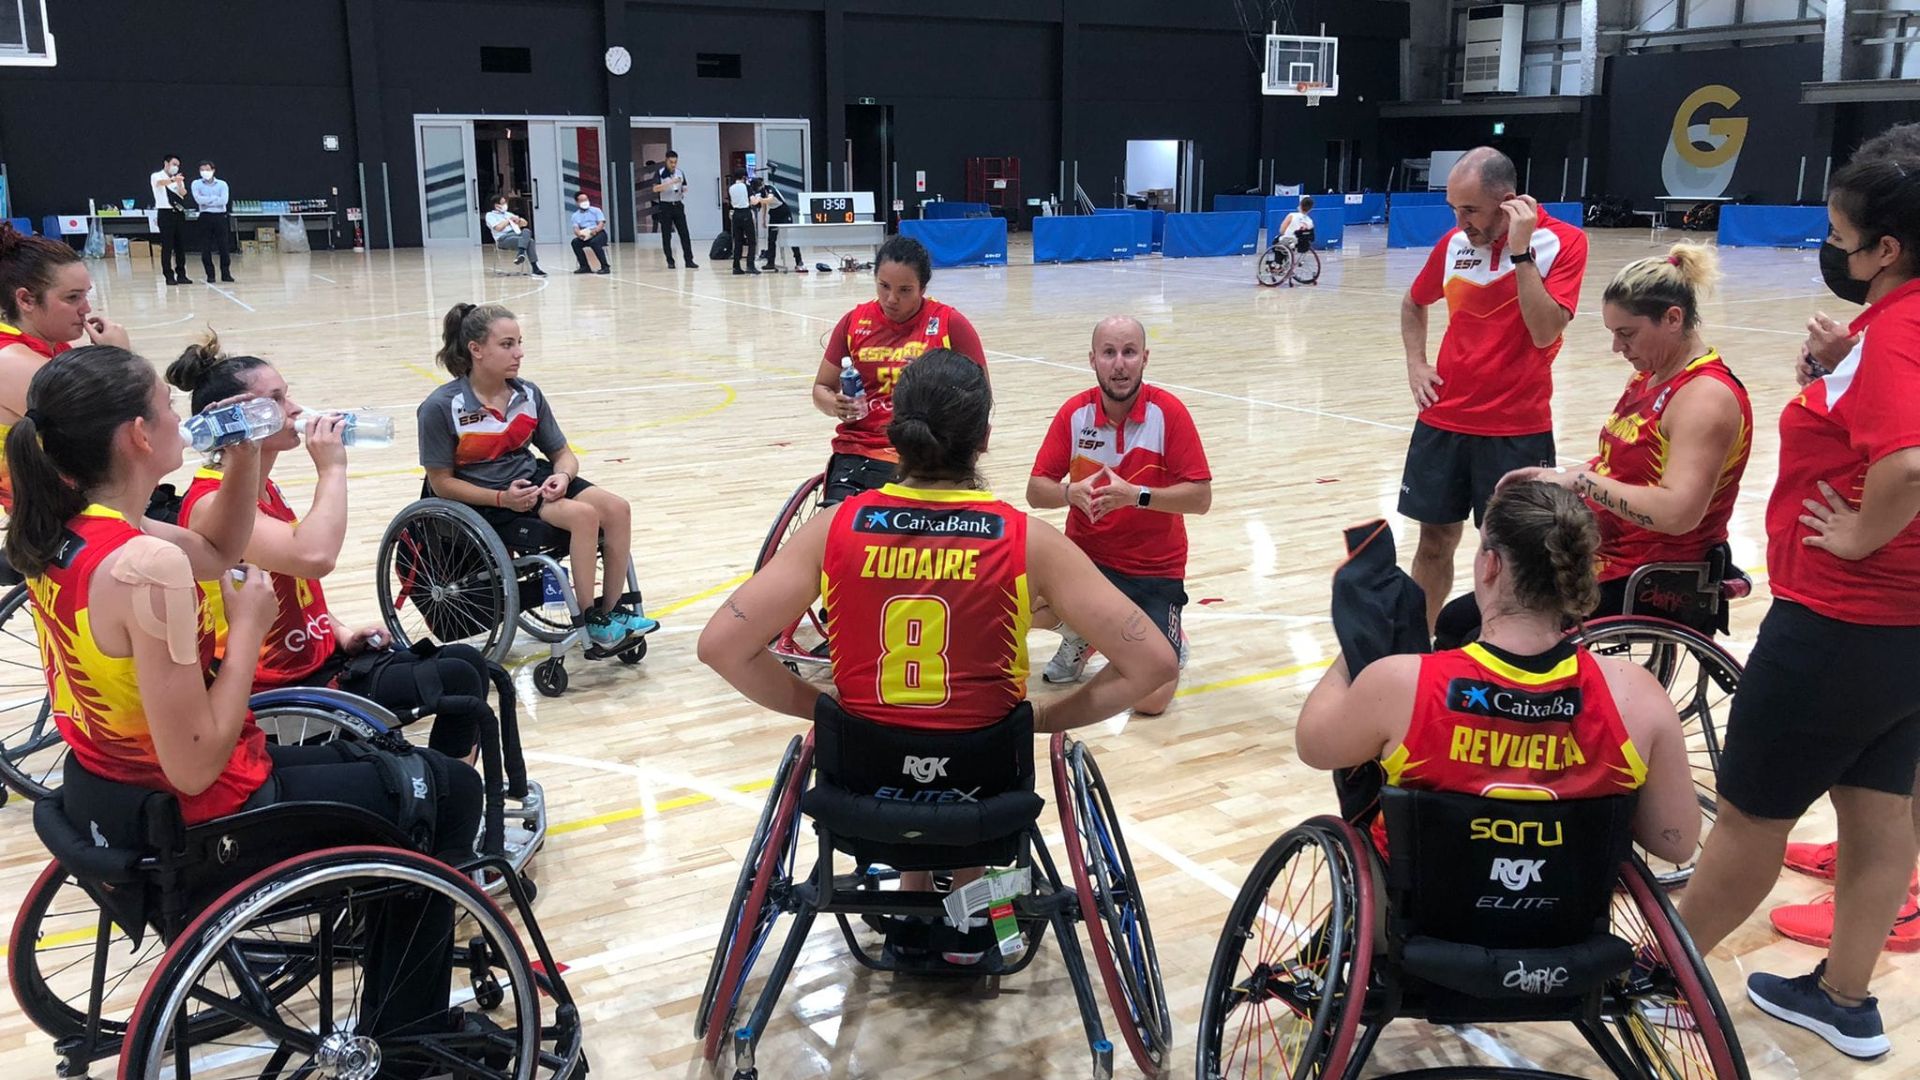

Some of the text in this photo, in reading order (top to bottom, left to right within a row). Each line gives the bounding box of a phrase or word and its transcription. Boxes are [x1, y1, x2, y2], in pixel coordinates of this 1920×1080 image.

[823, 199, 846, 210] 13:58
[816, 213, 828, 223] 41
[1453, 259, 1482, 270] ESP
[1078, 439, 1105, 451] ESP
[892, 511, 992, 534] CaixaBank
[860, 545, 981, 581] ZUDAIRE
[876, 594, 952, 709] 8
